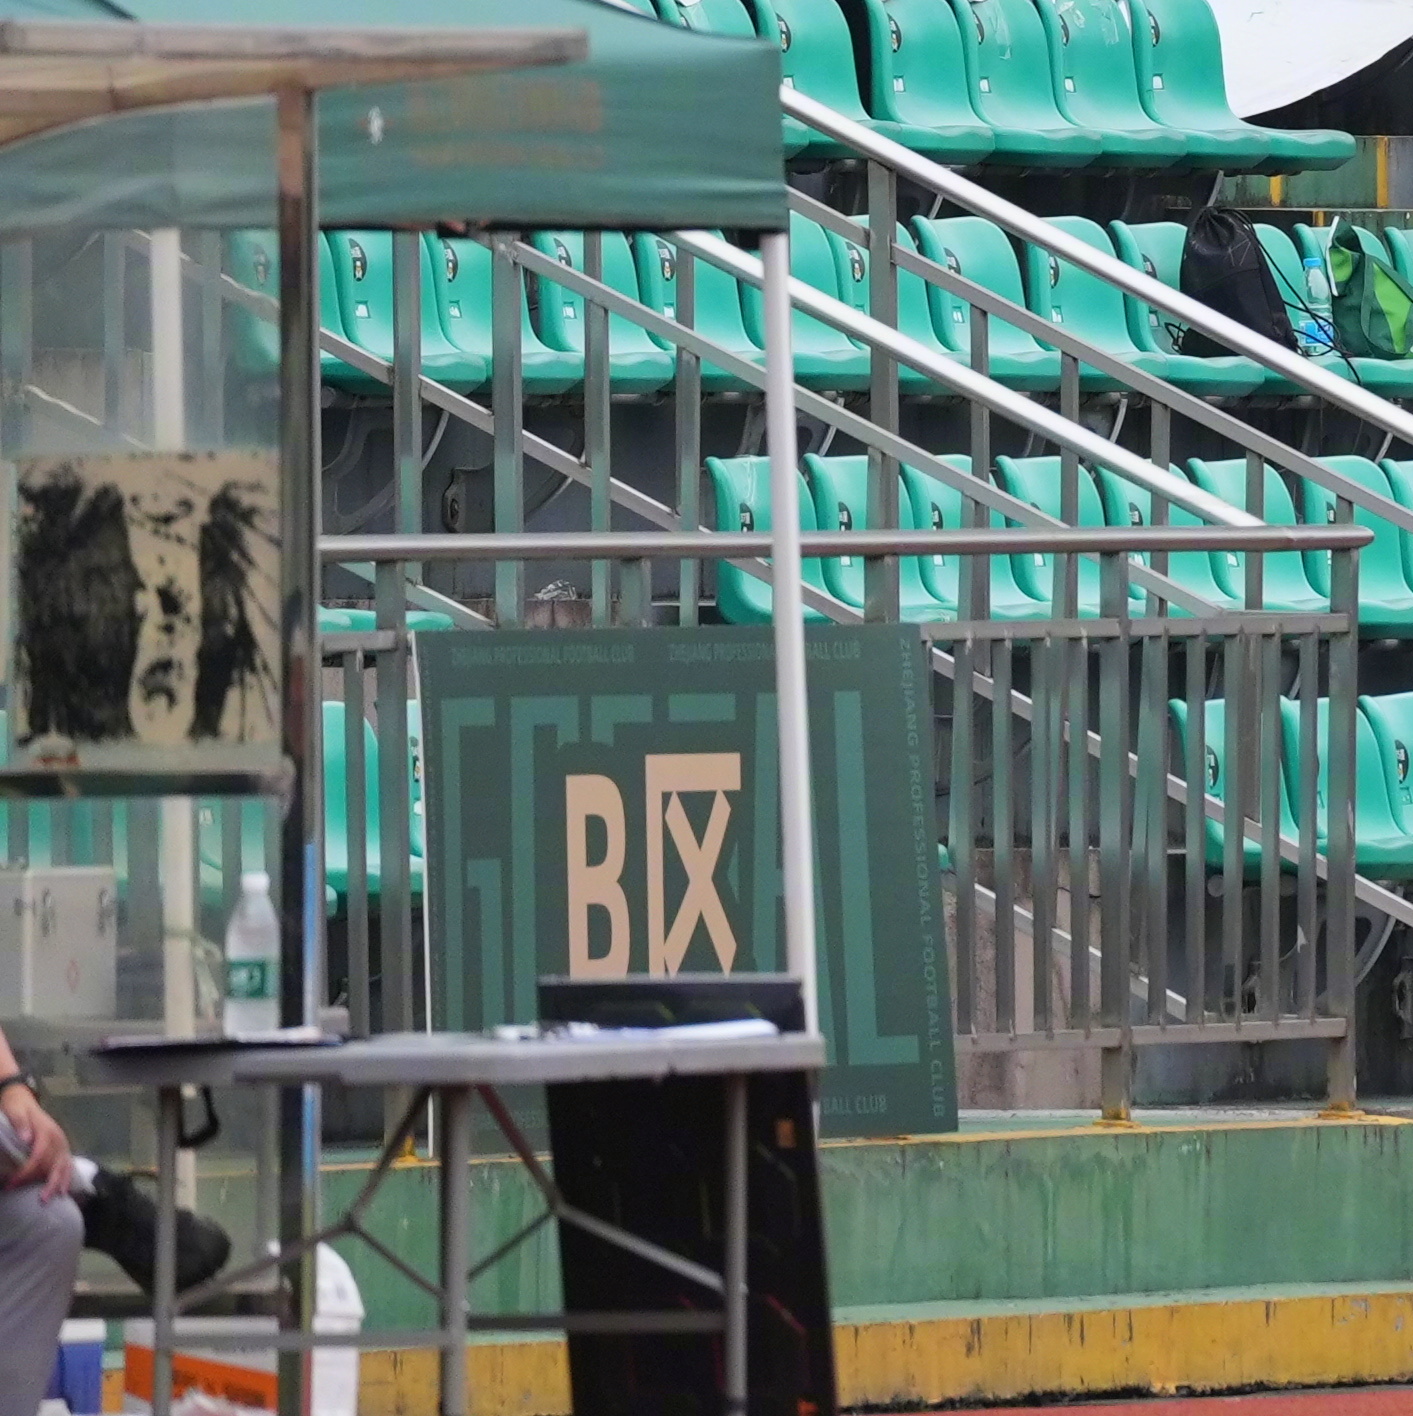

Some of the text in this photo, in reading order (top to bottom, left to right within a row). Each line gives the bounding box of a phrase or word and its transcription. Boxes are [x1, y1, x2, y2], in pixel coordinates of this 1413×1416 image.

[908, 754, 934, 924] PROFESSIONAL
[922, 935, 944, 1052] FOOTBALL
[930, 1058, 947, 1118] CLUB
